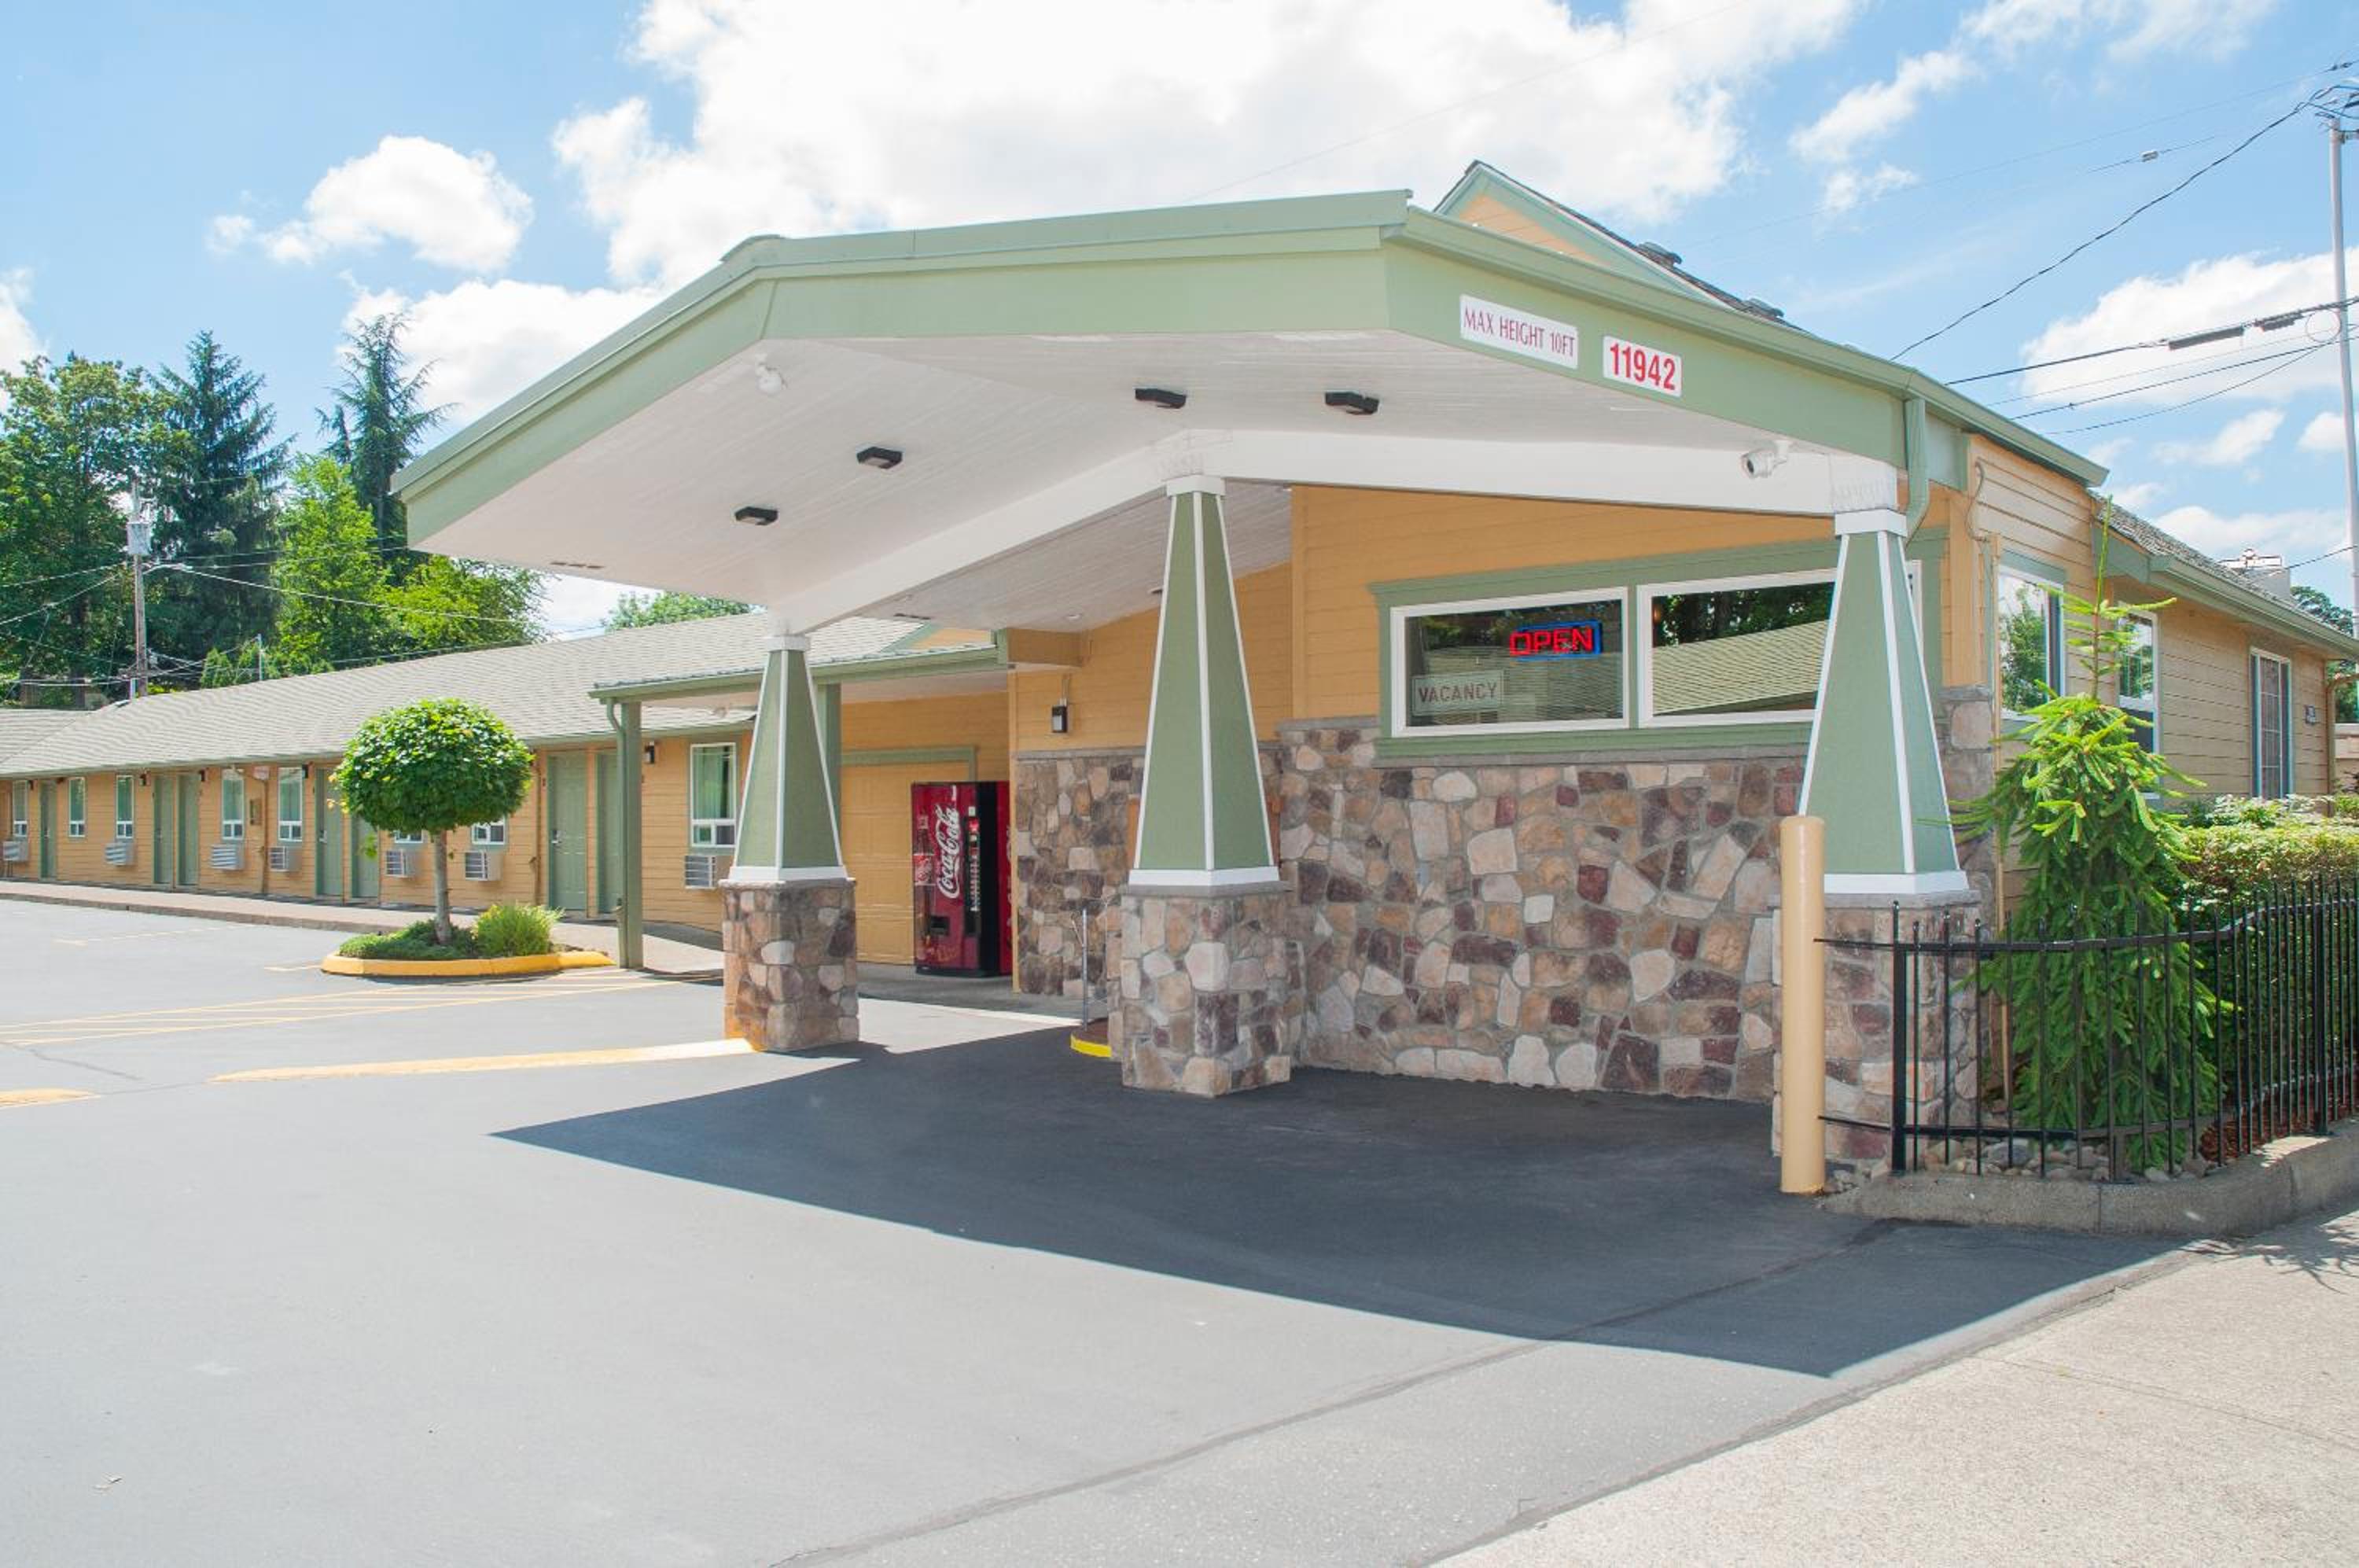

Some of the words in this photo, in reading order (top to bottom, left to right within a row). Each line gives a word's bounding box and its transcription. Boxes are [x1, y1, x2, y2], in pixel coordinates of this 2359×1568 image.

[1463, 307, 1493, 334] MAX
[1500, 316, 1544, 348] HEIGHT
[1550, 331, 1575, 357] 10FT
[1610, 343, 1676, 391] 11942
[1509, 626, 1593, 655] OPEN
[1418, 681, 1497, 703] VACANCY
